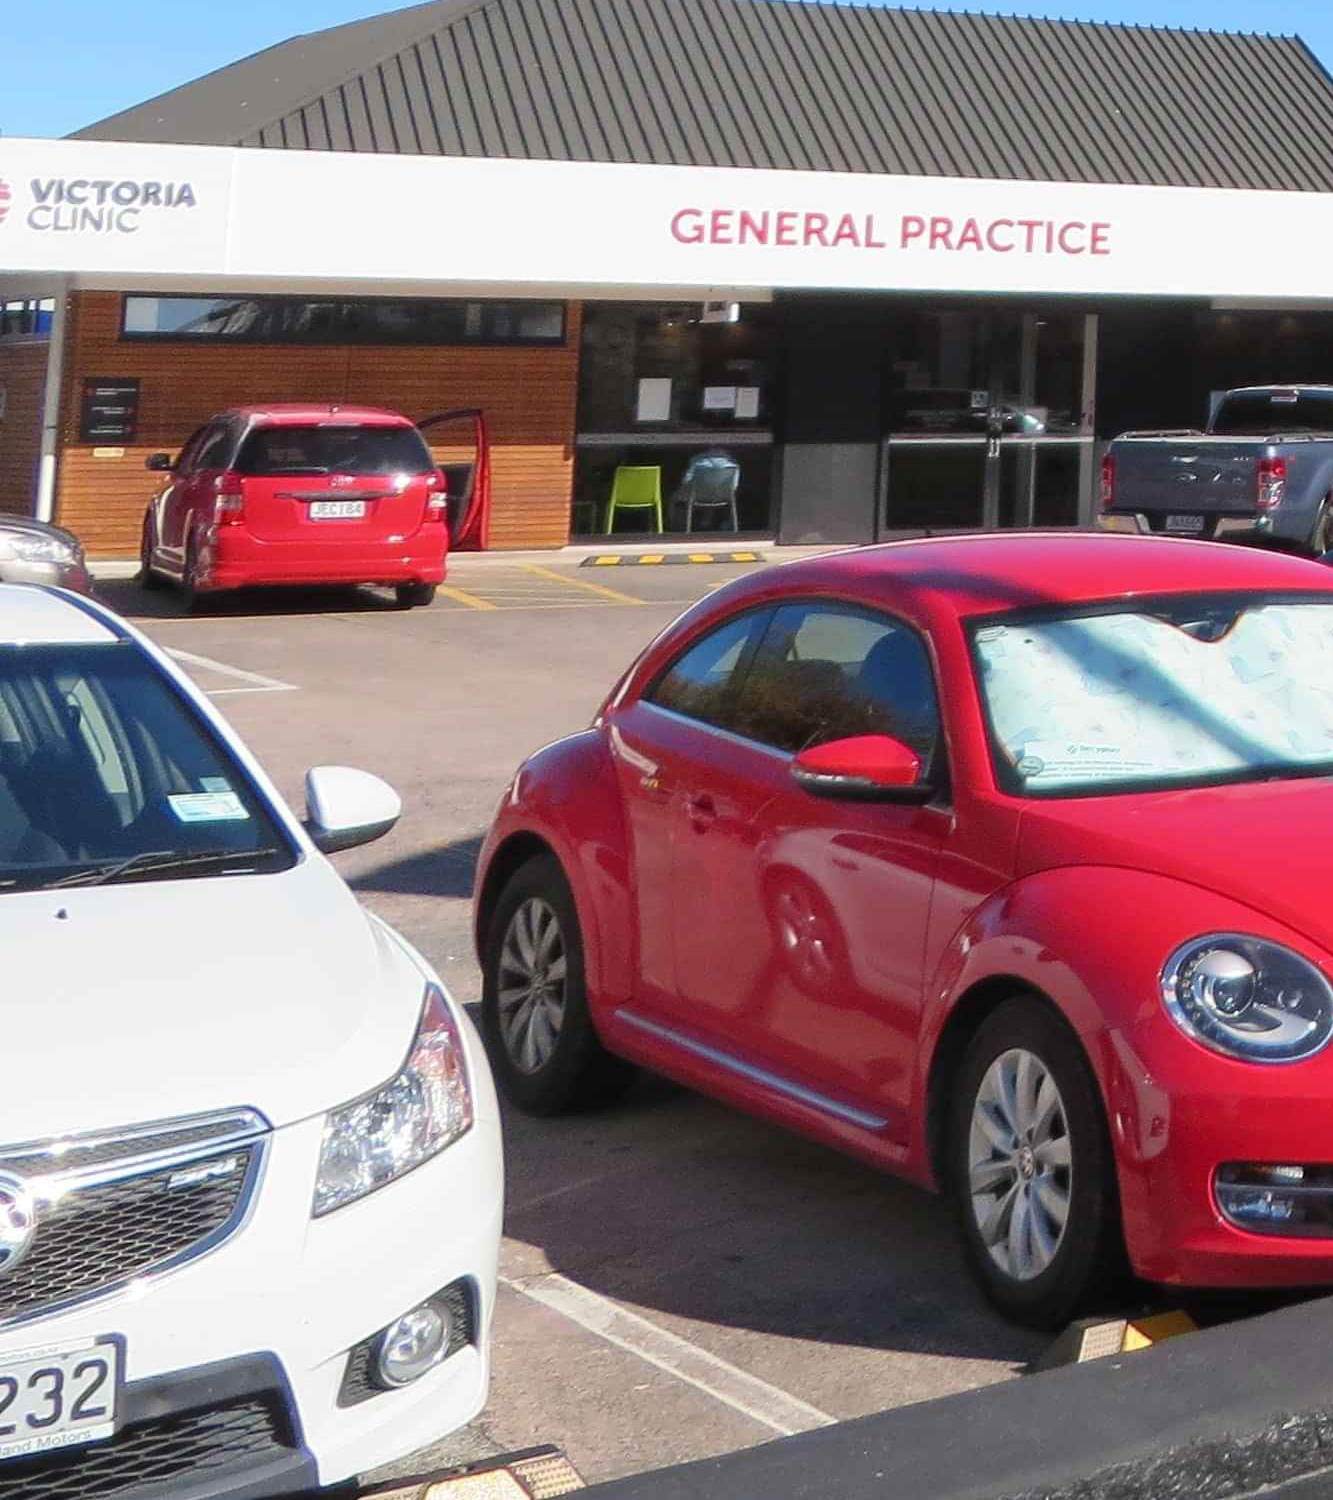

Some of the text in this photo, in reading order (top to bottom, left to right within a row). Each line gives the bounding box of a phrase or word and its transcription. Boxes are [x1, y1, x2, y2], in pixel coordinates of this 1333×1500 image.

[30, 178, 197, 207] VICTORIA
[27, 205, 142, 234] CLINIC
[670, 208, 1112, 255] GENERAL PRACTICE
[37, 1430, 92, 1448] Motors
